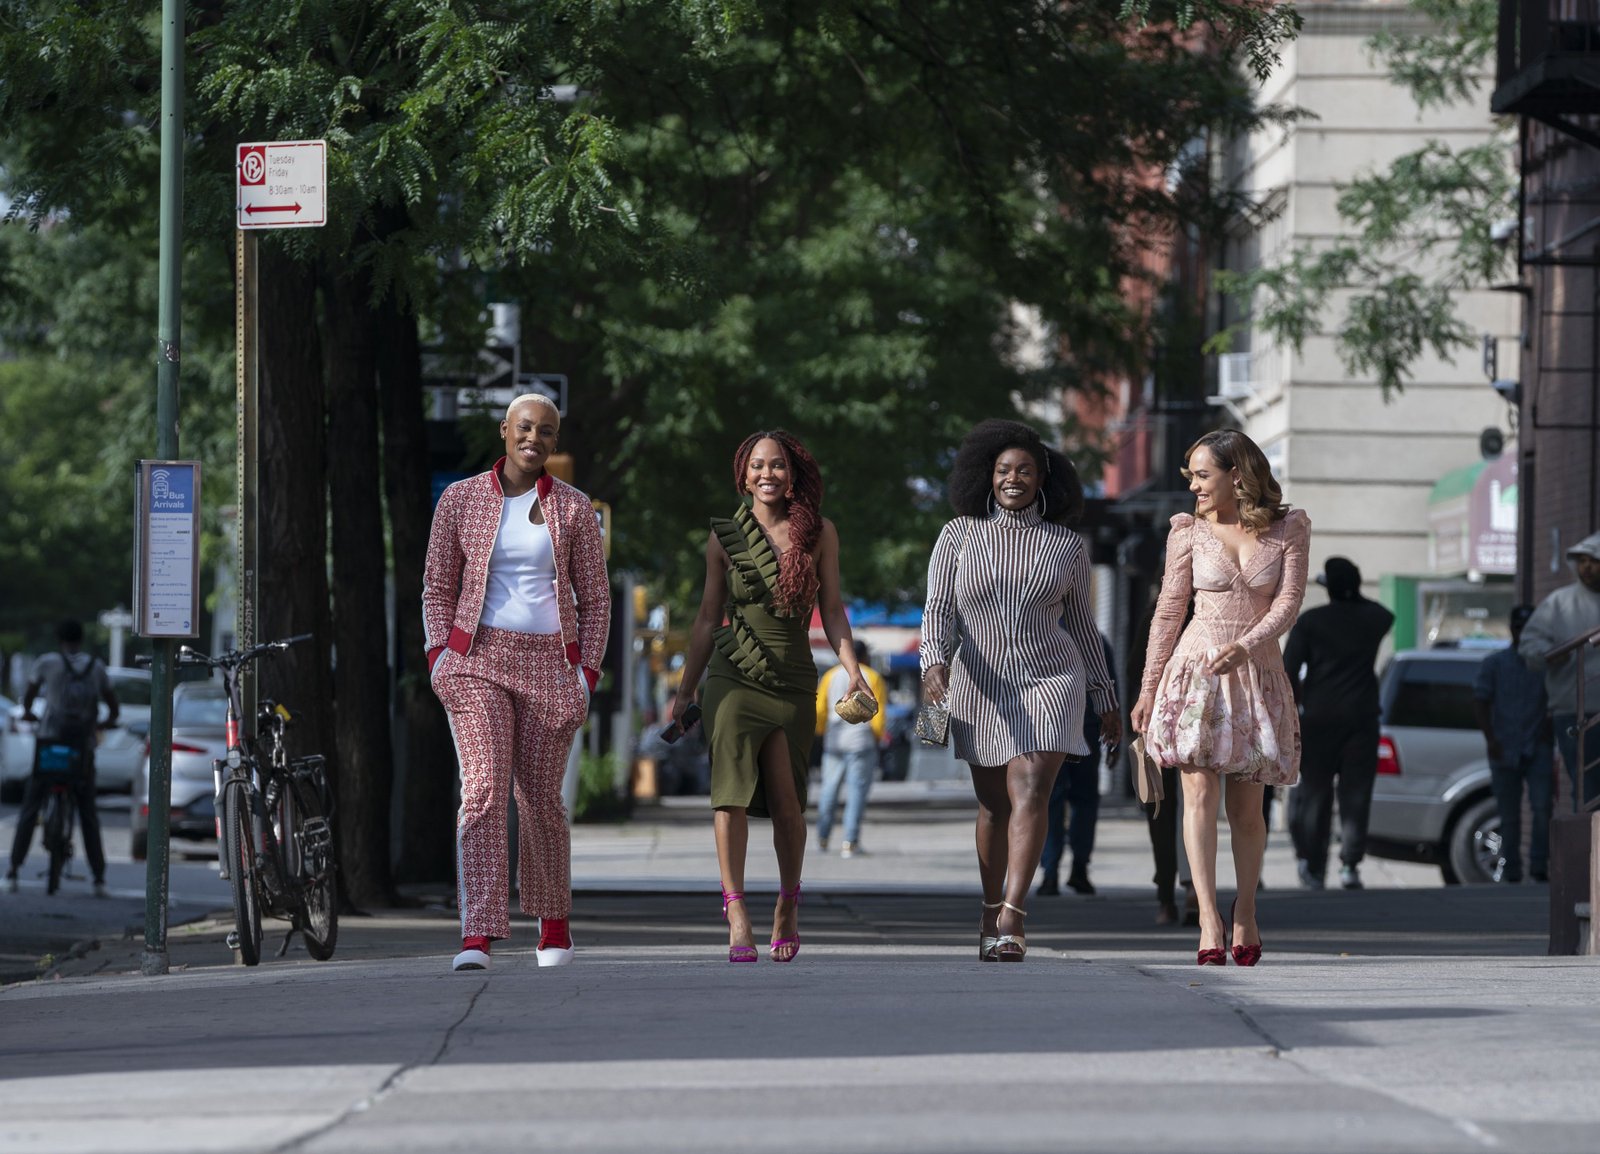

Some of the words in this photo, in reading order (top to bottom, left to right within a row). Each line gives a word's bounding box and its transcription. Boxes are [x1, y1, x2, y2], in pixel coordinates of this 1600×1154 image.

[269, 155, 295, 165] Tuesday
[269, 167, 289, 178] Friday
[299, 184, 318, 194] 10am
[169, 491, 185, 500] Bus
[153, 501, 185, 509] Arrivals
